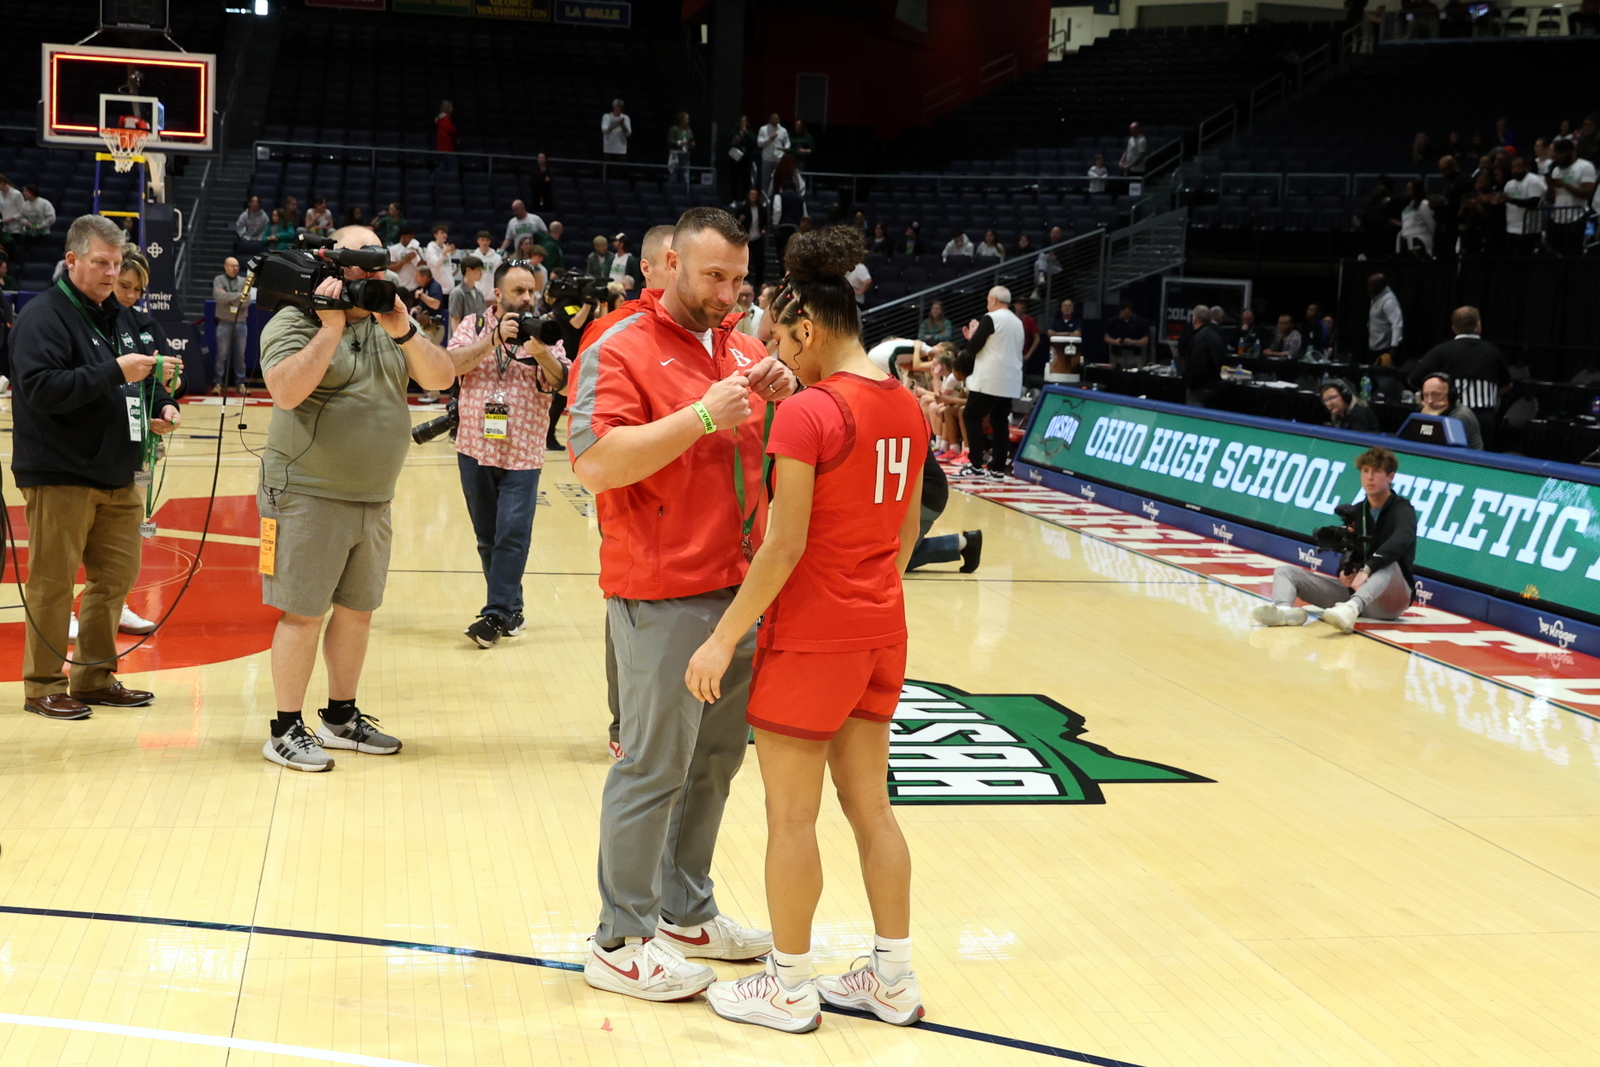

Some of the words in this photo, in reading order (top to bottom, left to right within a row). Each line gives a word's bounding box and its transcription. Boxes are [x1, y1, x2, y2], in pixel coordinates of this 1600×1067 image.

[476, 5, 548, 18] WASHINGTON
[1043, 415, 1079, 445] OHSAA
[873, 436, 911, 505] 14
[1084, 416, 1149, 466] OHIO
[1140, 427, 1220, 483] HIGH
[1212, 441, 1347, 515] SCHOOL
[1351, 472, 1591, 572] THLETIC
[1549, 620, 1577, 649] Kroger
